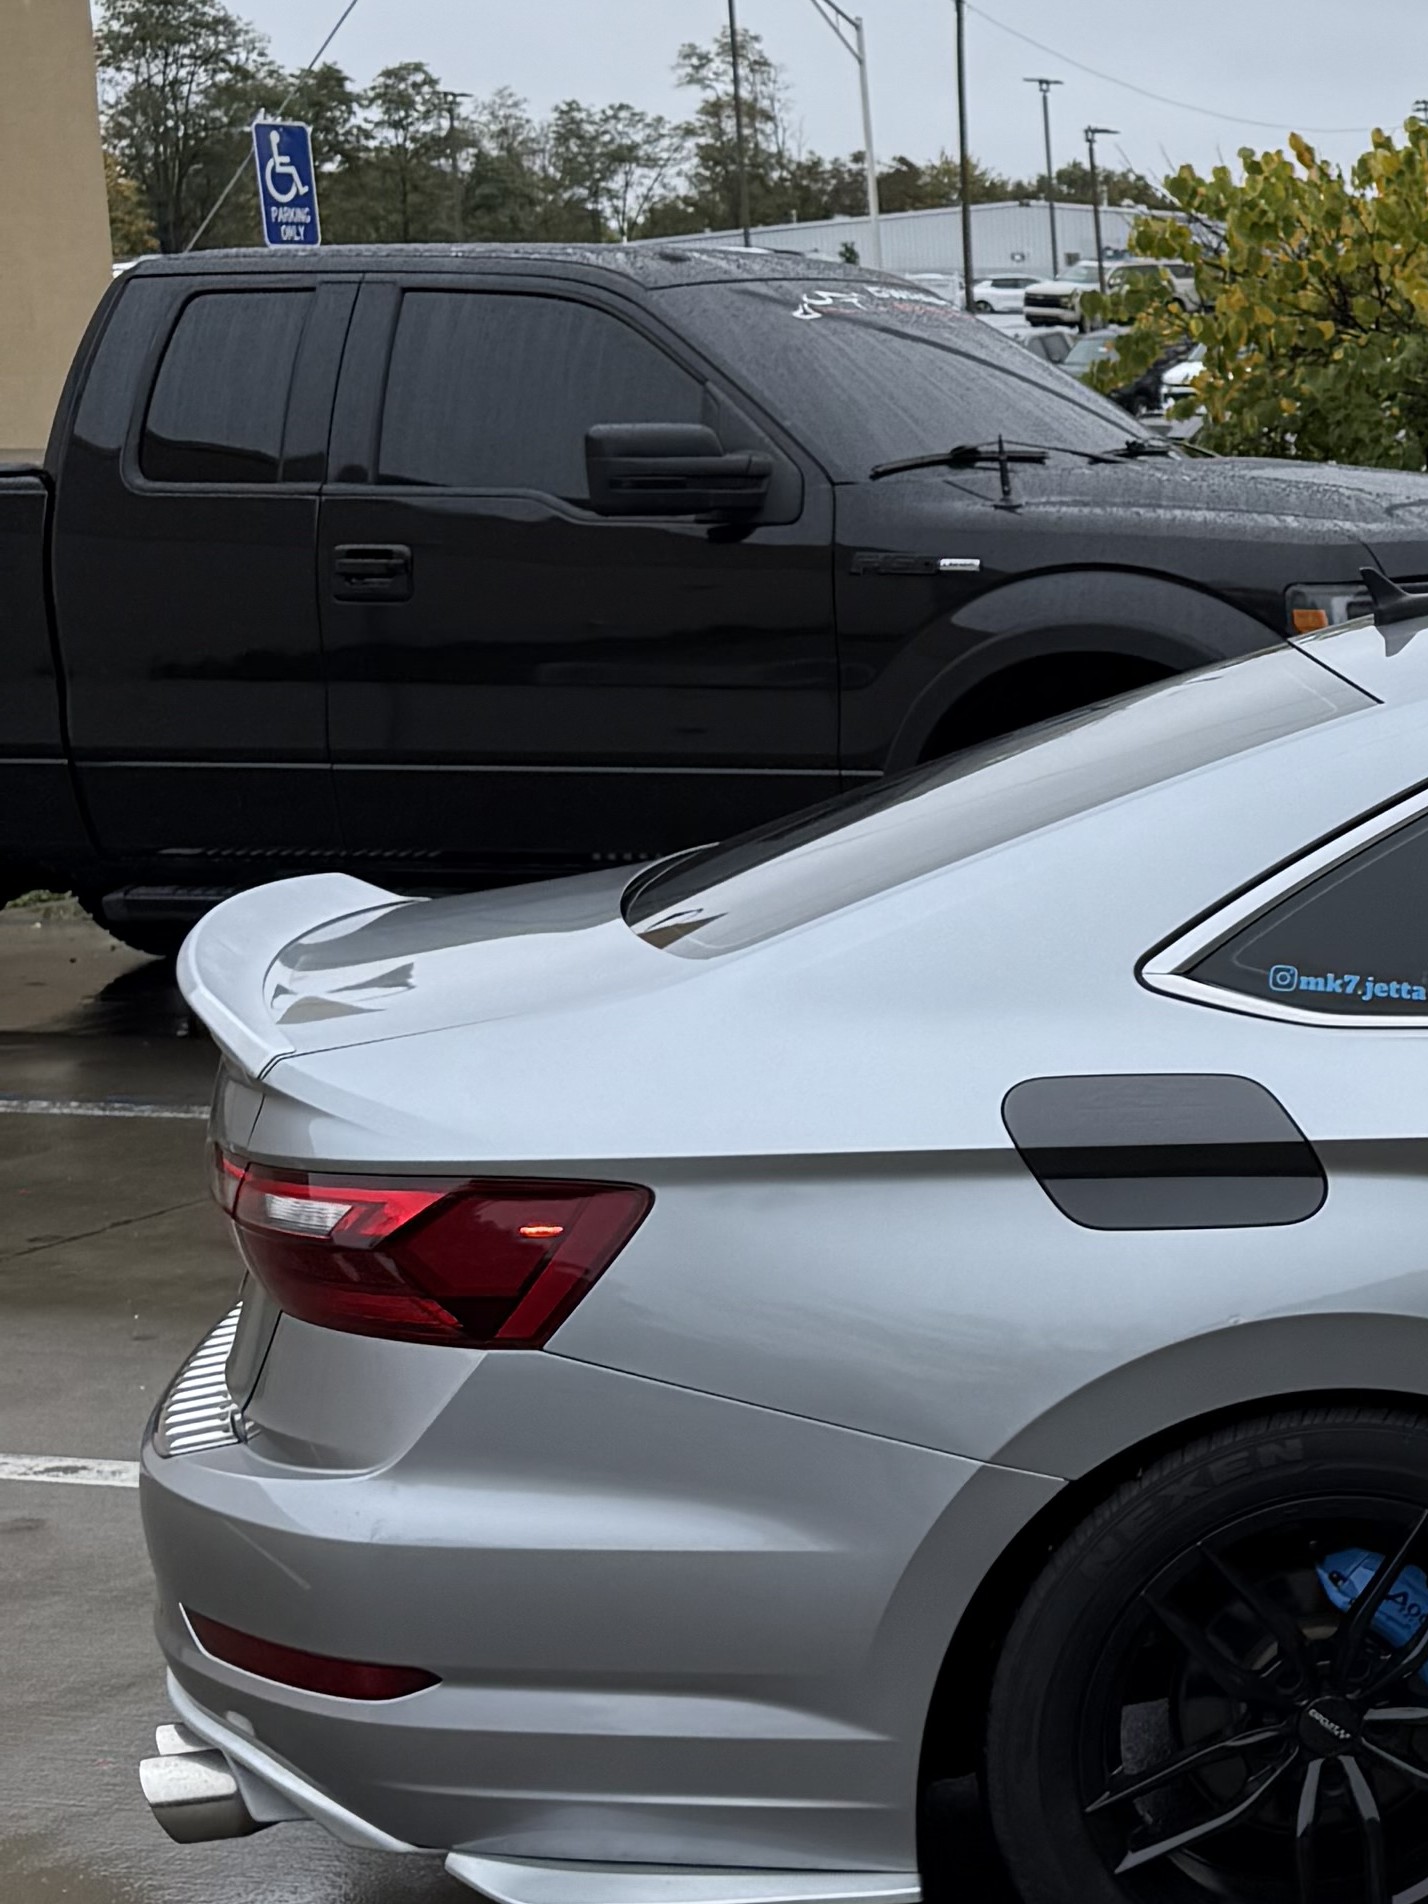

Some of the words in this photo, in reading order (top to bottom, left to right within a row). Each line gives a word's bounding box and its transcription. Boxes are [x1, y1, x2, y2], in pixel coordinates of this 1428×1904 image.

[270, 206, 311, 223] PARKING
[281, 225, 304, 240] ONLY
[1299, 973, 1427, 1001] mk7.jetta
[1079, 1438, 1305, 1580] NEXEN
